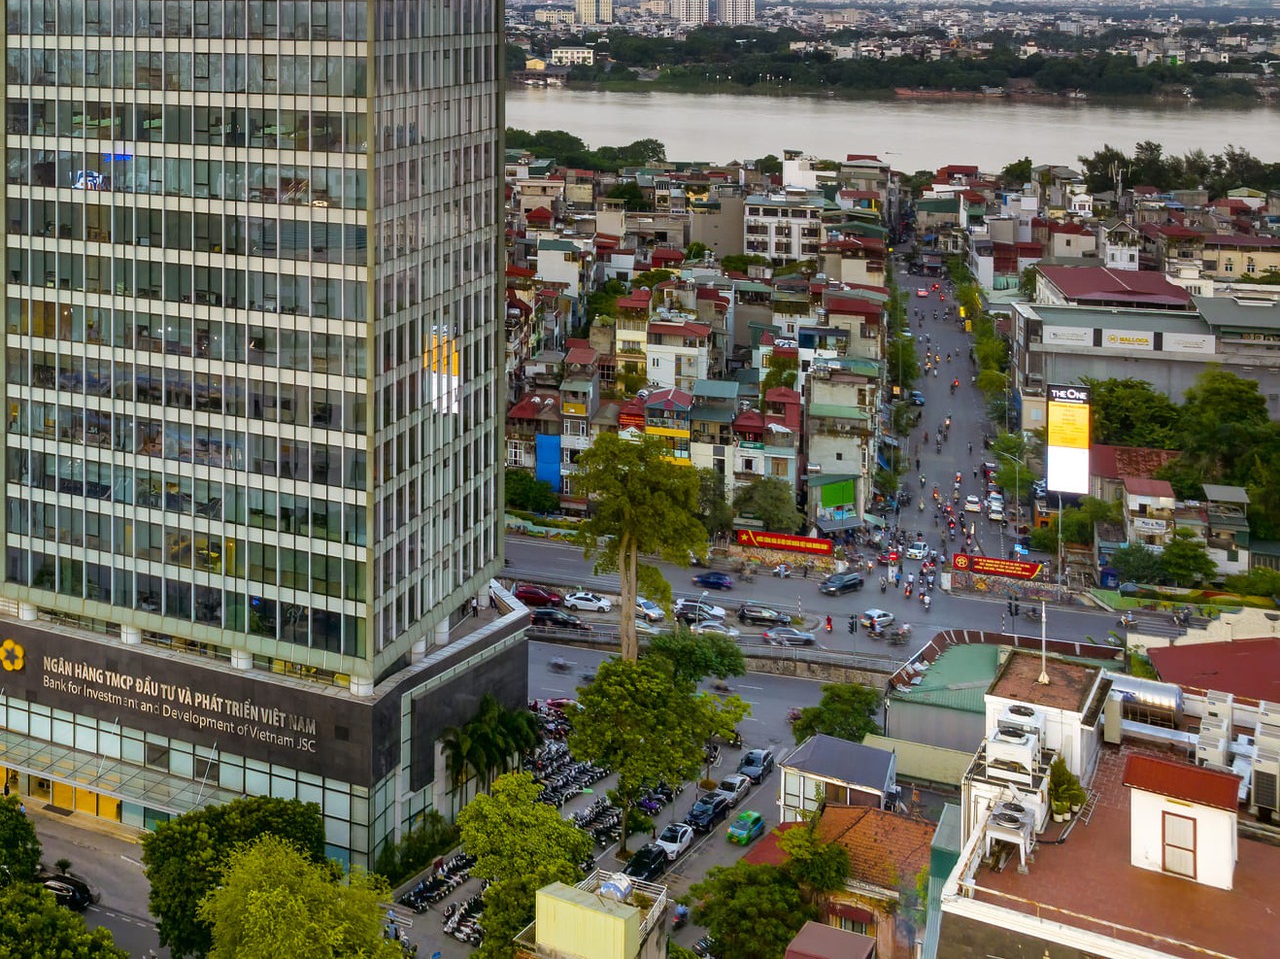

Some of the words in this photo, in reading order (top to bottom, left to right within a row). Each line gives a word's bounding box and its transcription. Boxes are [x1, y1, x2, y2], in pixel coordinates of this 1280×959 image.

[43, 655, 72, 677] NGÂN
[74, 661, 103, 684] HÀNG
[105, 670, 134, 691] TMCP
[135, 675, 158, 697] ĐẦU
[160, 683, 176, 701] TƯ
[177, 686, 193, 706] VÀ
[194, 692, 224, 713] PHÁT
[225, 698, 259, 722] TRIỂN
[288, 714, 317, 735] NAM
[43, 675, 67, 692] Bank
[67, 680, 82, 695] for
[83, 684, 139, 709] Investment
[140, 701, 160, 716] and
[163, 704, 235, 734] Development
[236, 724, 249, 737] of
[249, 726, 294, 749] Vietnam
[296, 738, 317, 753] JSC
